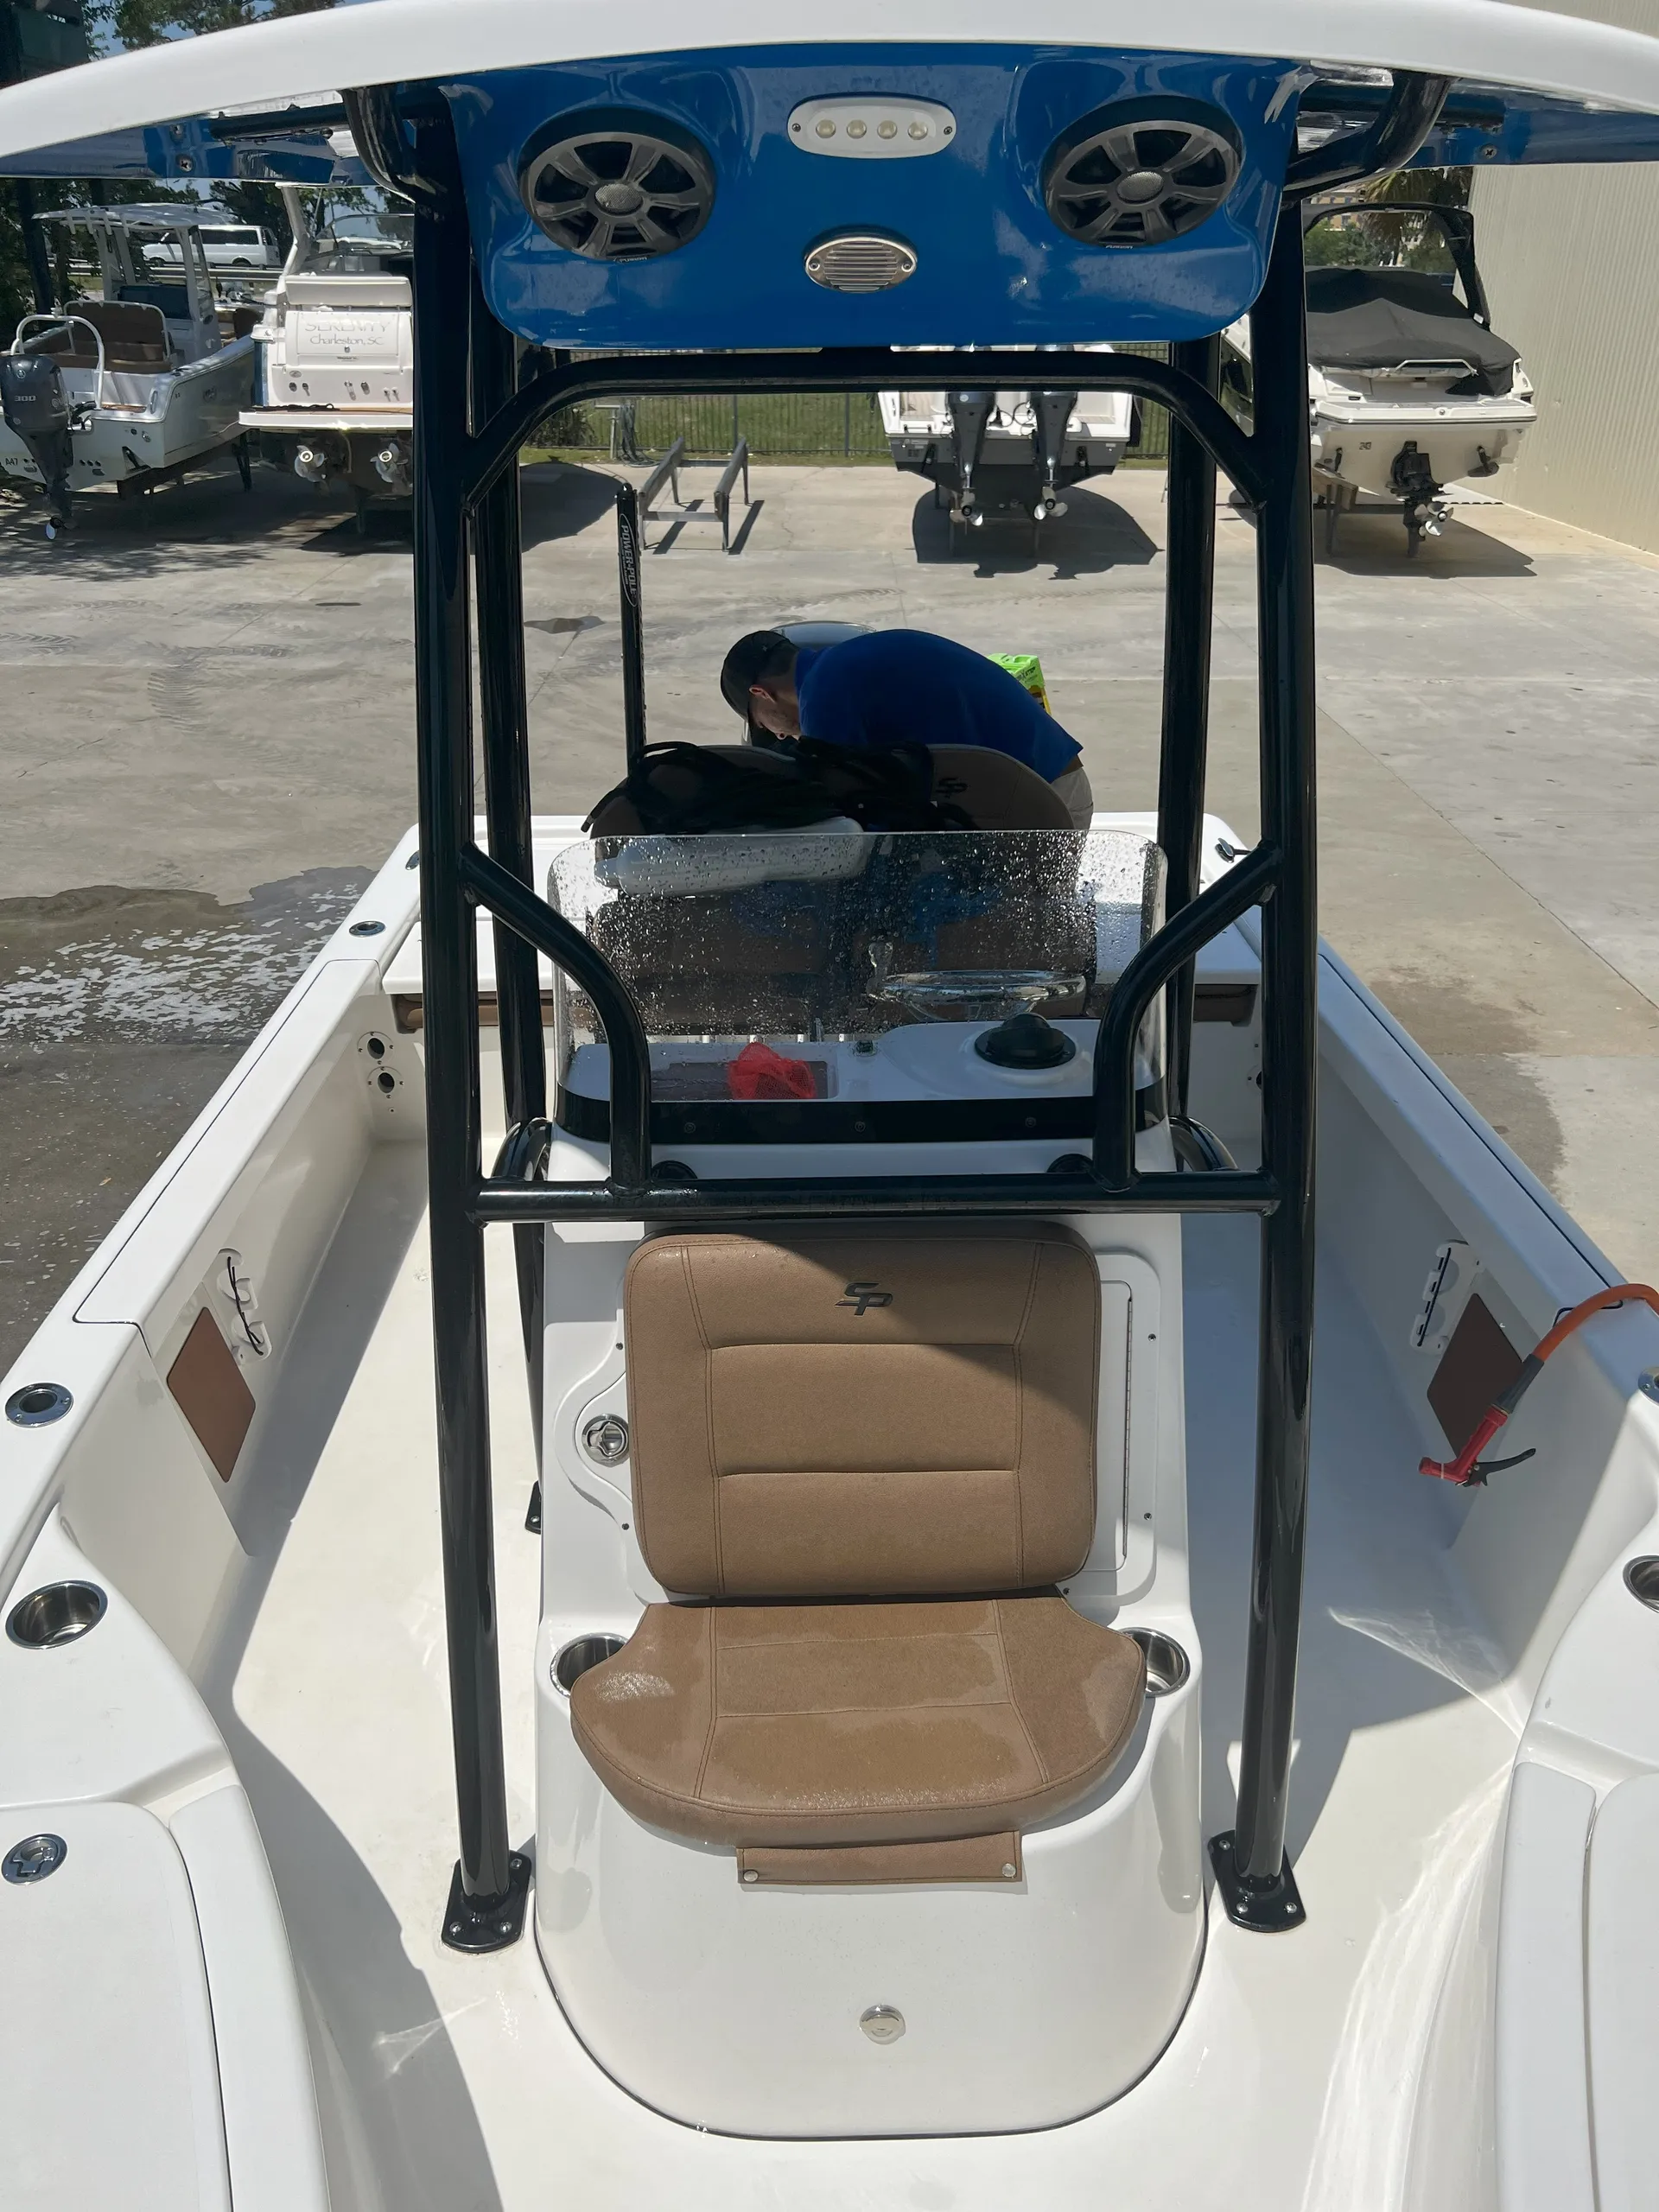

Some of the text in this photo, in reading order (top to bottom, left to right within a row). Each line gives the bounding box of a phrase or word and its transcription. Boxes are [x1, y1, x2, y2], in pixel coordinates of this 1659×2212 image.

[309, 334, 384, 346] Charleston, SC
[620, 524, 637, 594] POWER-POLE
